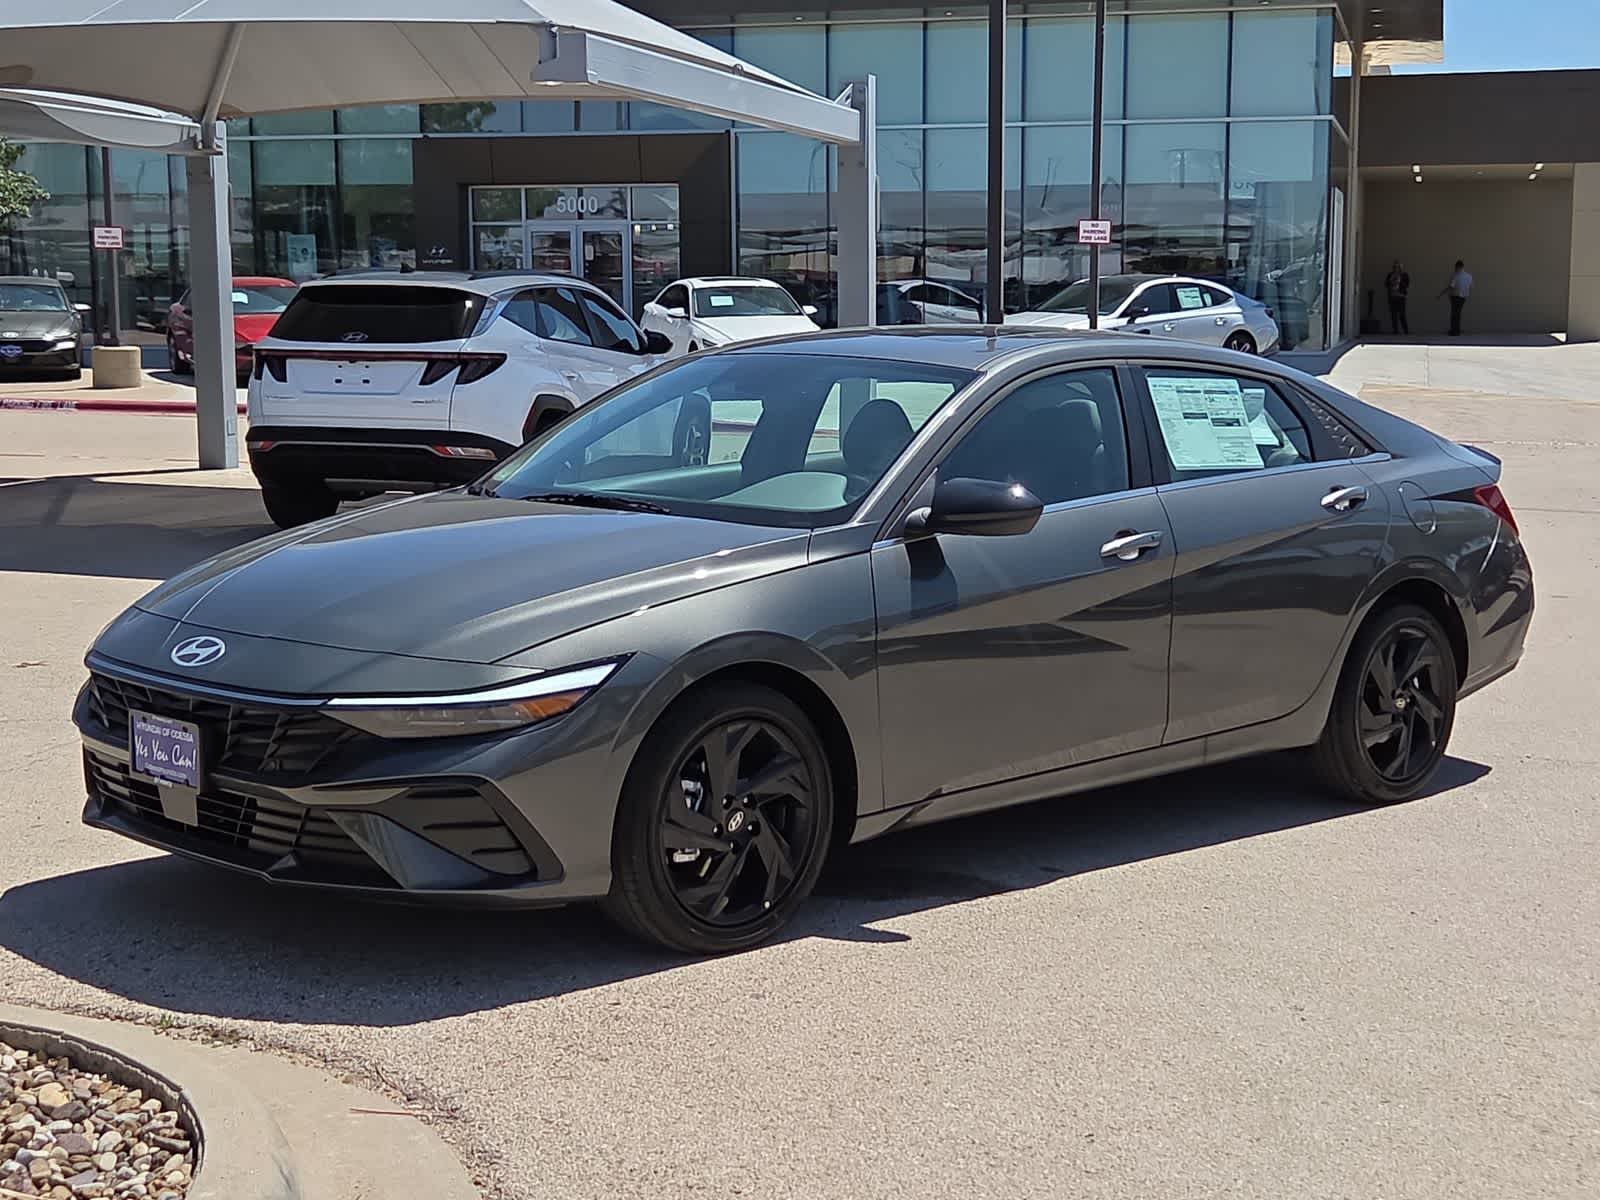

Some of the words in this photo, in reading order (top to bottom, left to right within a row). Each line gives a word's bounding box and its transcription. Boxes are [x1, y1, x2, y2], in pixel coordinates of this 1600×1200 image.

[556, 196, 598, 213] 5000
[134, 735, 149, 760] Yes
[151, 740, 169, 761] You
[171, 745, 197, 771] Can!
